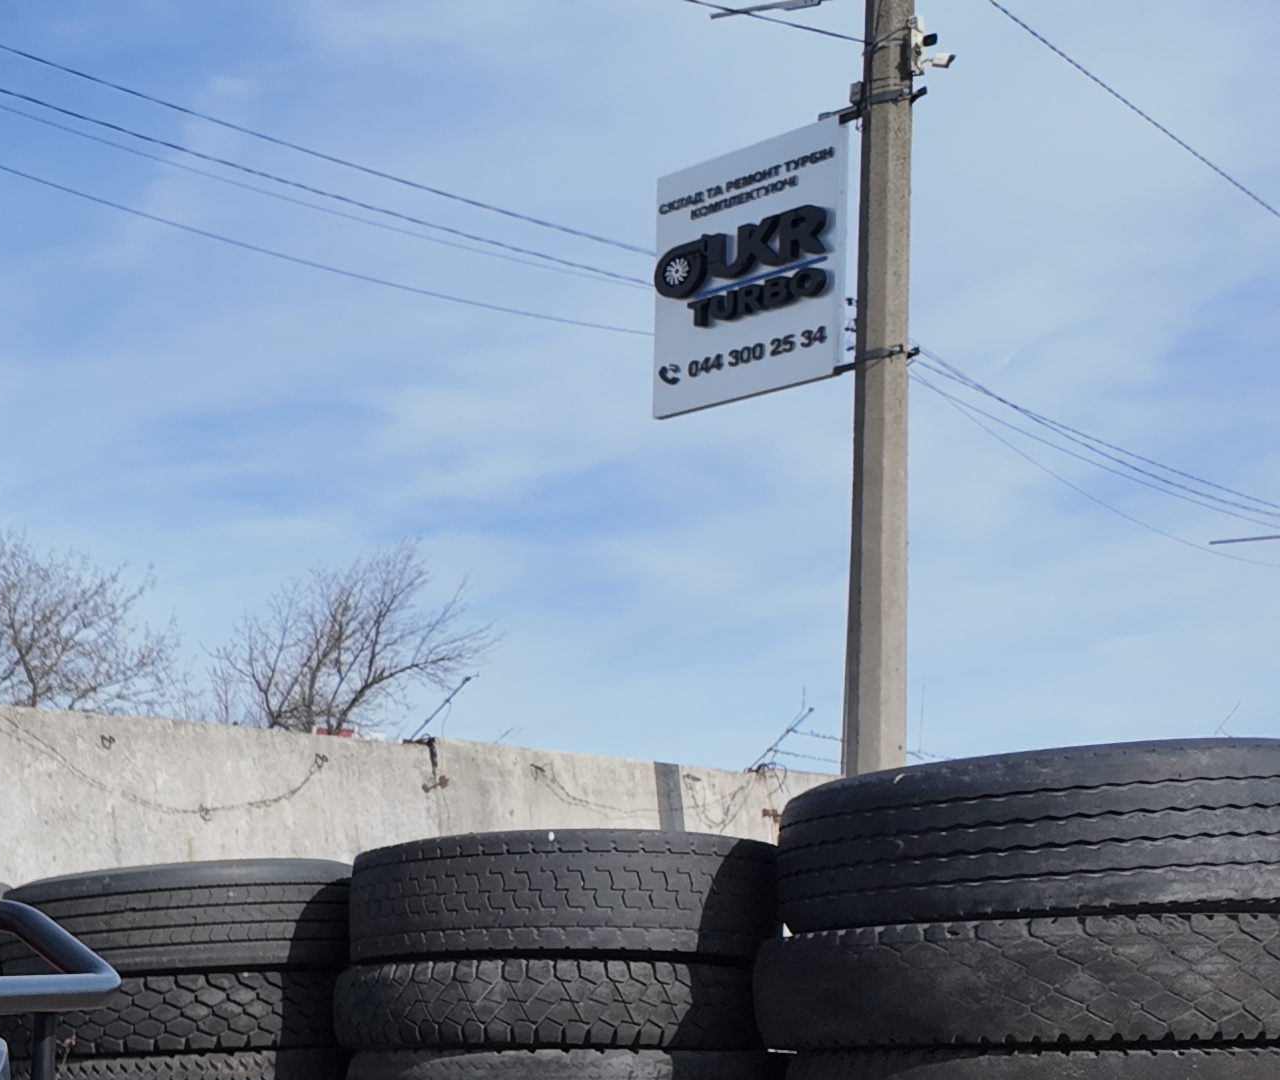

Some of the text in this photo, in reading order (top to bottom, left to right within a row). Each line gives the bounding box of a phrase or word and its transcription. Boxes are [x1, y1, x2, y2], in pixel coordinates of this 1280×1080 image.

[658, 146, 835, 215] СКЛАД ТА РЕМОНТ ТУРБІН
[690, 175, 799, 220] КОМПЛЕКТУЮЧІ
[705, 204, 828, 279] UKR
[687, 267, 828, 328] TURBO
[688, 325, 828, 378] 044 300 25 34
